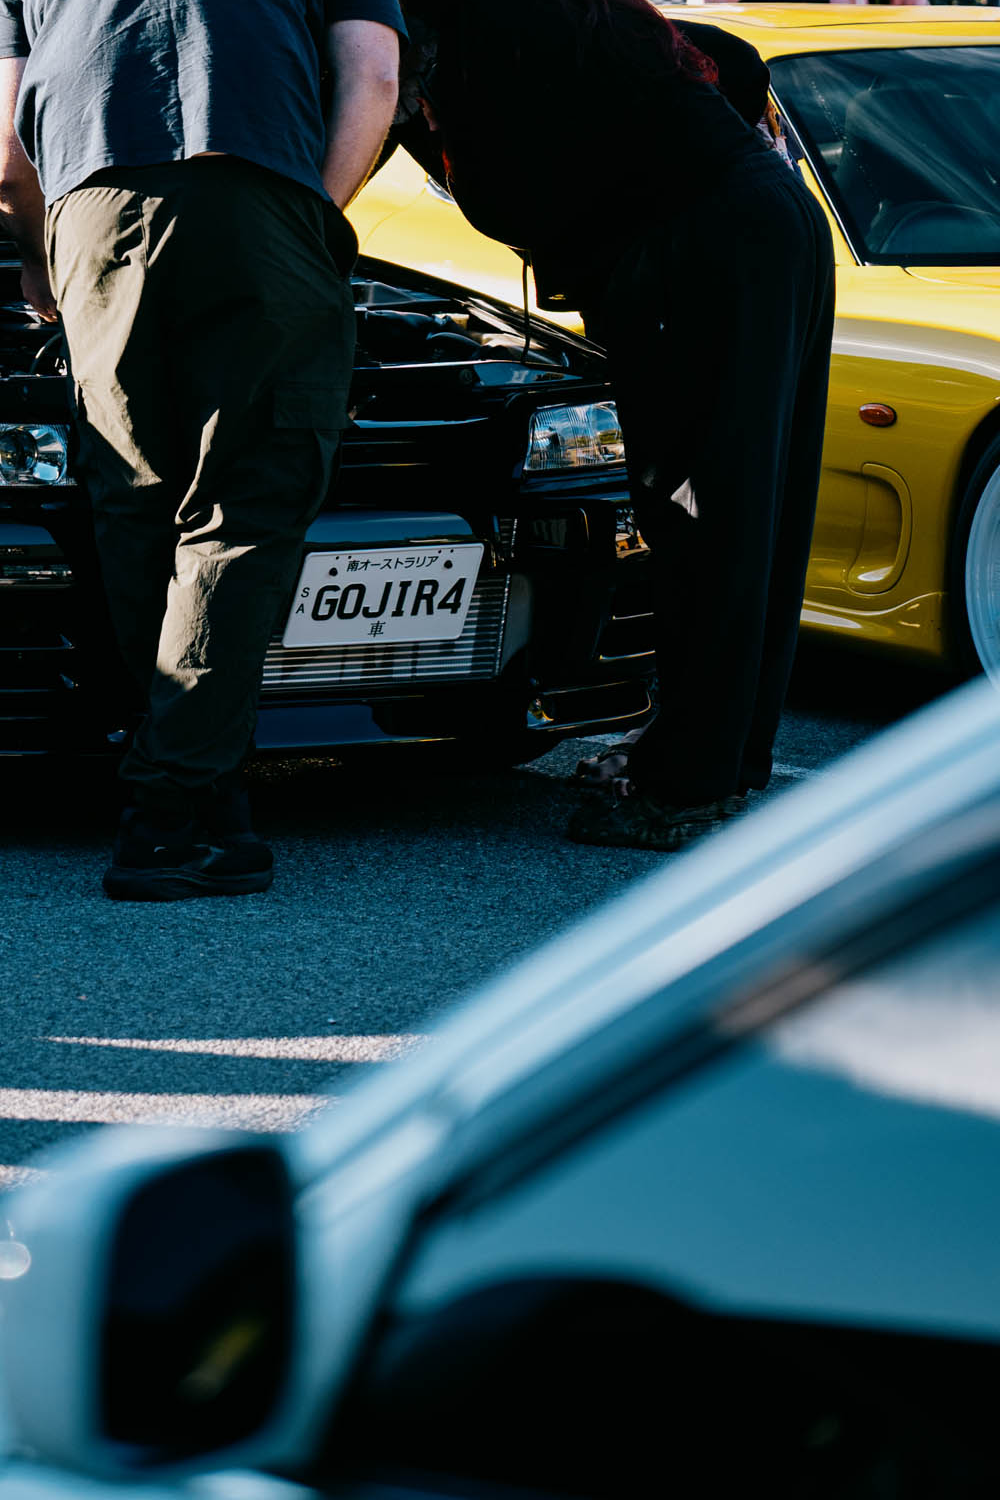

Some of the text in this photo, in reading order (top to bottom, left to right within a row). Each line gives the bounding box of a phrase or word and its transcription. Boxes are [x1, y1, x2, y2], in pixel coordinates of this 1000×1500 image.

[346, 555, 440, 573] 南オーストラリア
[311, 578, 467, 621] GOJIR4
[367, 620, 386, 638] 車
